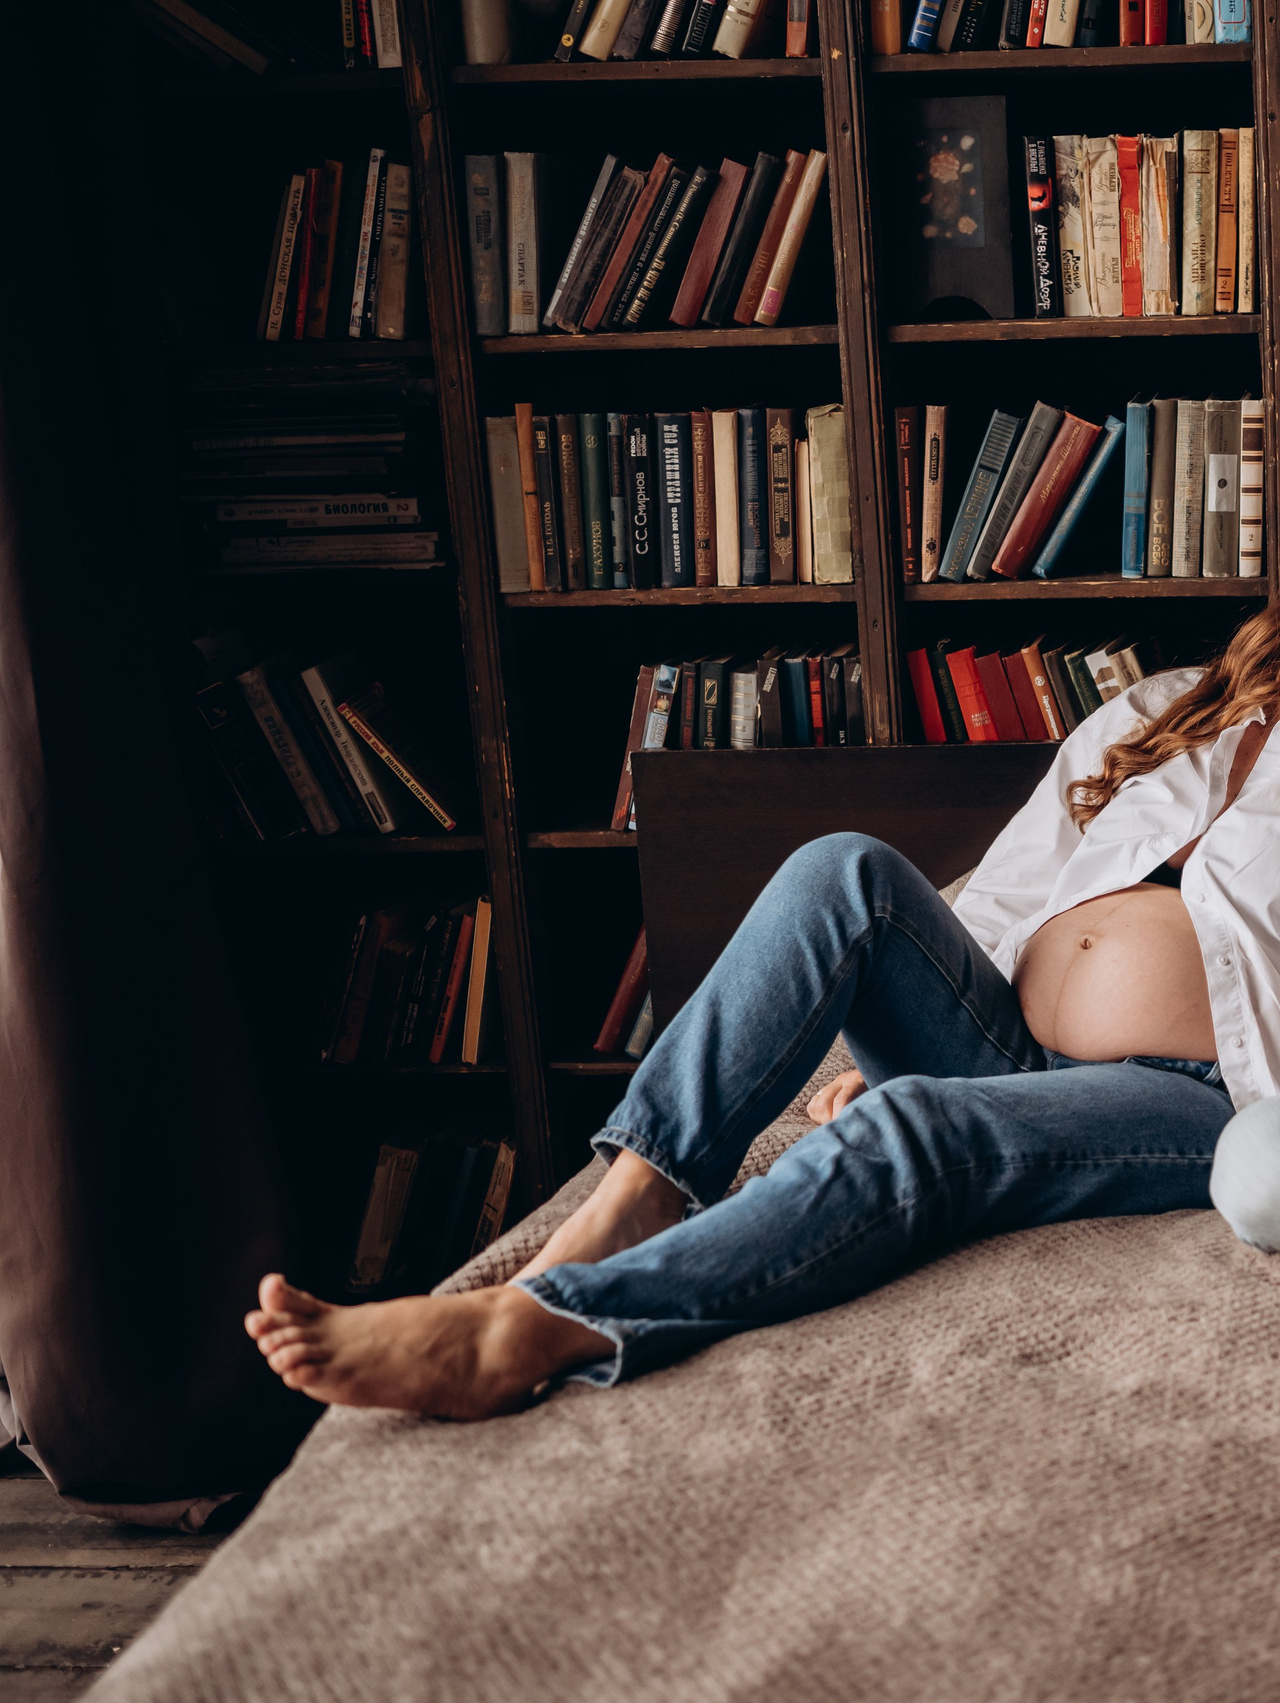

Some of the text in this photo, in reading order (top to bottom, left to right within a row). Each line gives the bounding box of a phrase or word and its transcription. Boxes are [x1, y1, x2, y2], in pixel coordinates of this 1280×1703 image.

[1028, 143, 1038, 172] В.ВАСИЛЬЕВ
[692, 175, 701, 184] В.
[1194, 176, 1203, 225] ИЗБРАННОЕ
[270, 187, 301, 330] Н. Сухов ДОНСКАЯ ПОВЕСТЬ
[560, 196, 598, 283] АНАТОЛИЙ ПРИСТАВКИН
[1198, 233, 1207, 284] ЗОЩЕНКО
[642, 269, 660, 289] ЧЕГО
[1033, 221, 1054, 310] ДНЕВНОЙ ДОЗОР
[1061, 249, 1076, 295] КАМЕНСКИЙ
[1071, 254, 1082, 289] ВАСИЛИЙ
[1190, 241, 1199, 283] МИХАИЛ
[636, 287, 651, 301] НЕ
[1221, 279, 1227, 289] 2
[625, 298, 646, 325] БЫЛО
[662, 423, 681, 504] СТРАШНЫЙ СУД
[1037, 423, 1081, 504] Мариэтта Шагинян
[323, 502, 387, 514] БИОЛОГИЯ
[394, 502, 409, 511] 2
[632, 470, 651, 554] С. С. Смирнов
[945, 470, 992, 577] РАССКАЗЫ ЛЕНИНЕ
[981, 466, 1028, 555] ВАЛЕНТИН ПИКУЛЬ
[1151, 497, 1167, 532] ВСЕ
[542, 501, 554, 555] Н. ГОГОЛЬ
[670, 506, 681, 572] АЛЕКСЕЙ ЮГОВ
[1151, 535, 1161, 563] ВСЕМ
[1248, 533, 1255, 544] 2
[1161, 541, 1169, 563] ОБО
[317, 696, 343, 738] Александр
[383, 754, 412, 785] ПОЛНЫЙ
[408, 781, 449, 825] СПРАВОЧНИК
